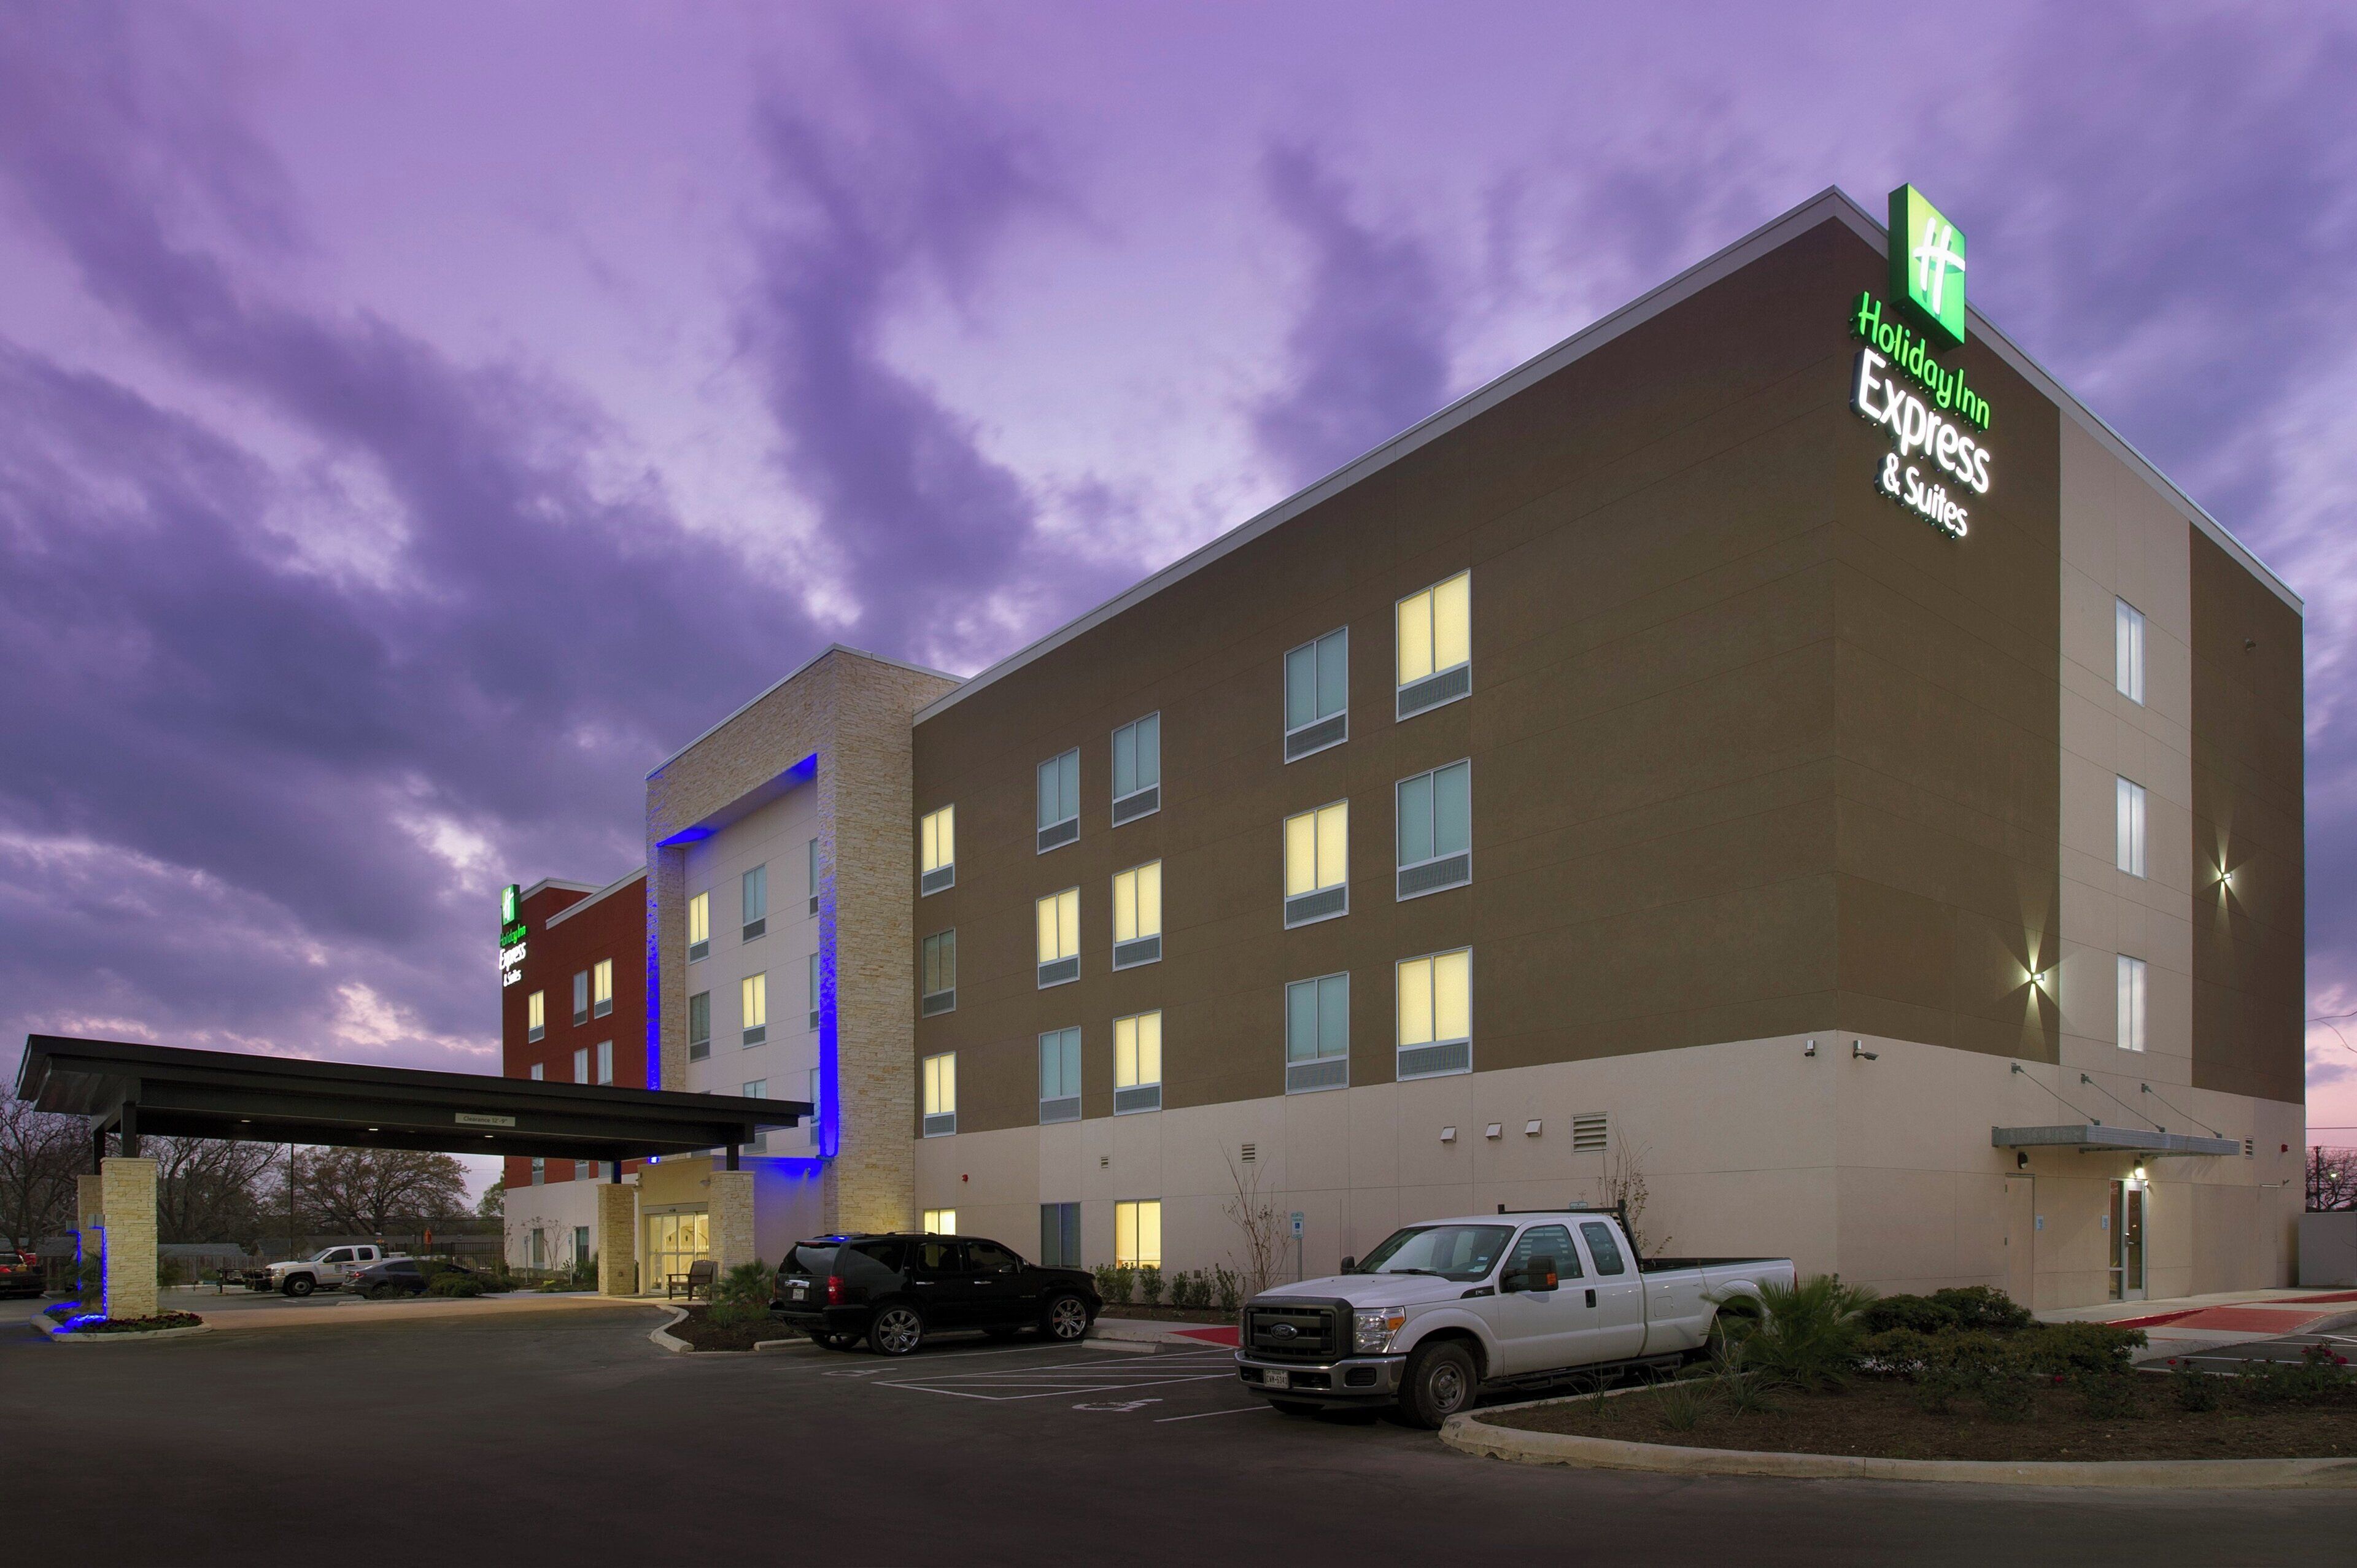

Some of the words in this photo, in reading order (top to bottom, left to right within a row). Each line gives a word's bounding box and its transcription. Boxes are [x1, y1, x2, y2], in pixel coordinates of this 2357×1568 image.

[1857, 291, 1953, 409] Holiday
[1955, 368, 1991, 430] Inn
[1857, 347, 1991, 494] Express
[1882, 452, 1902, 497] &
[1903, 466, 1969, 537] Suites
[498, 941, 527, 972] Express
[1274, 1327, 1290, 1336] Ford
